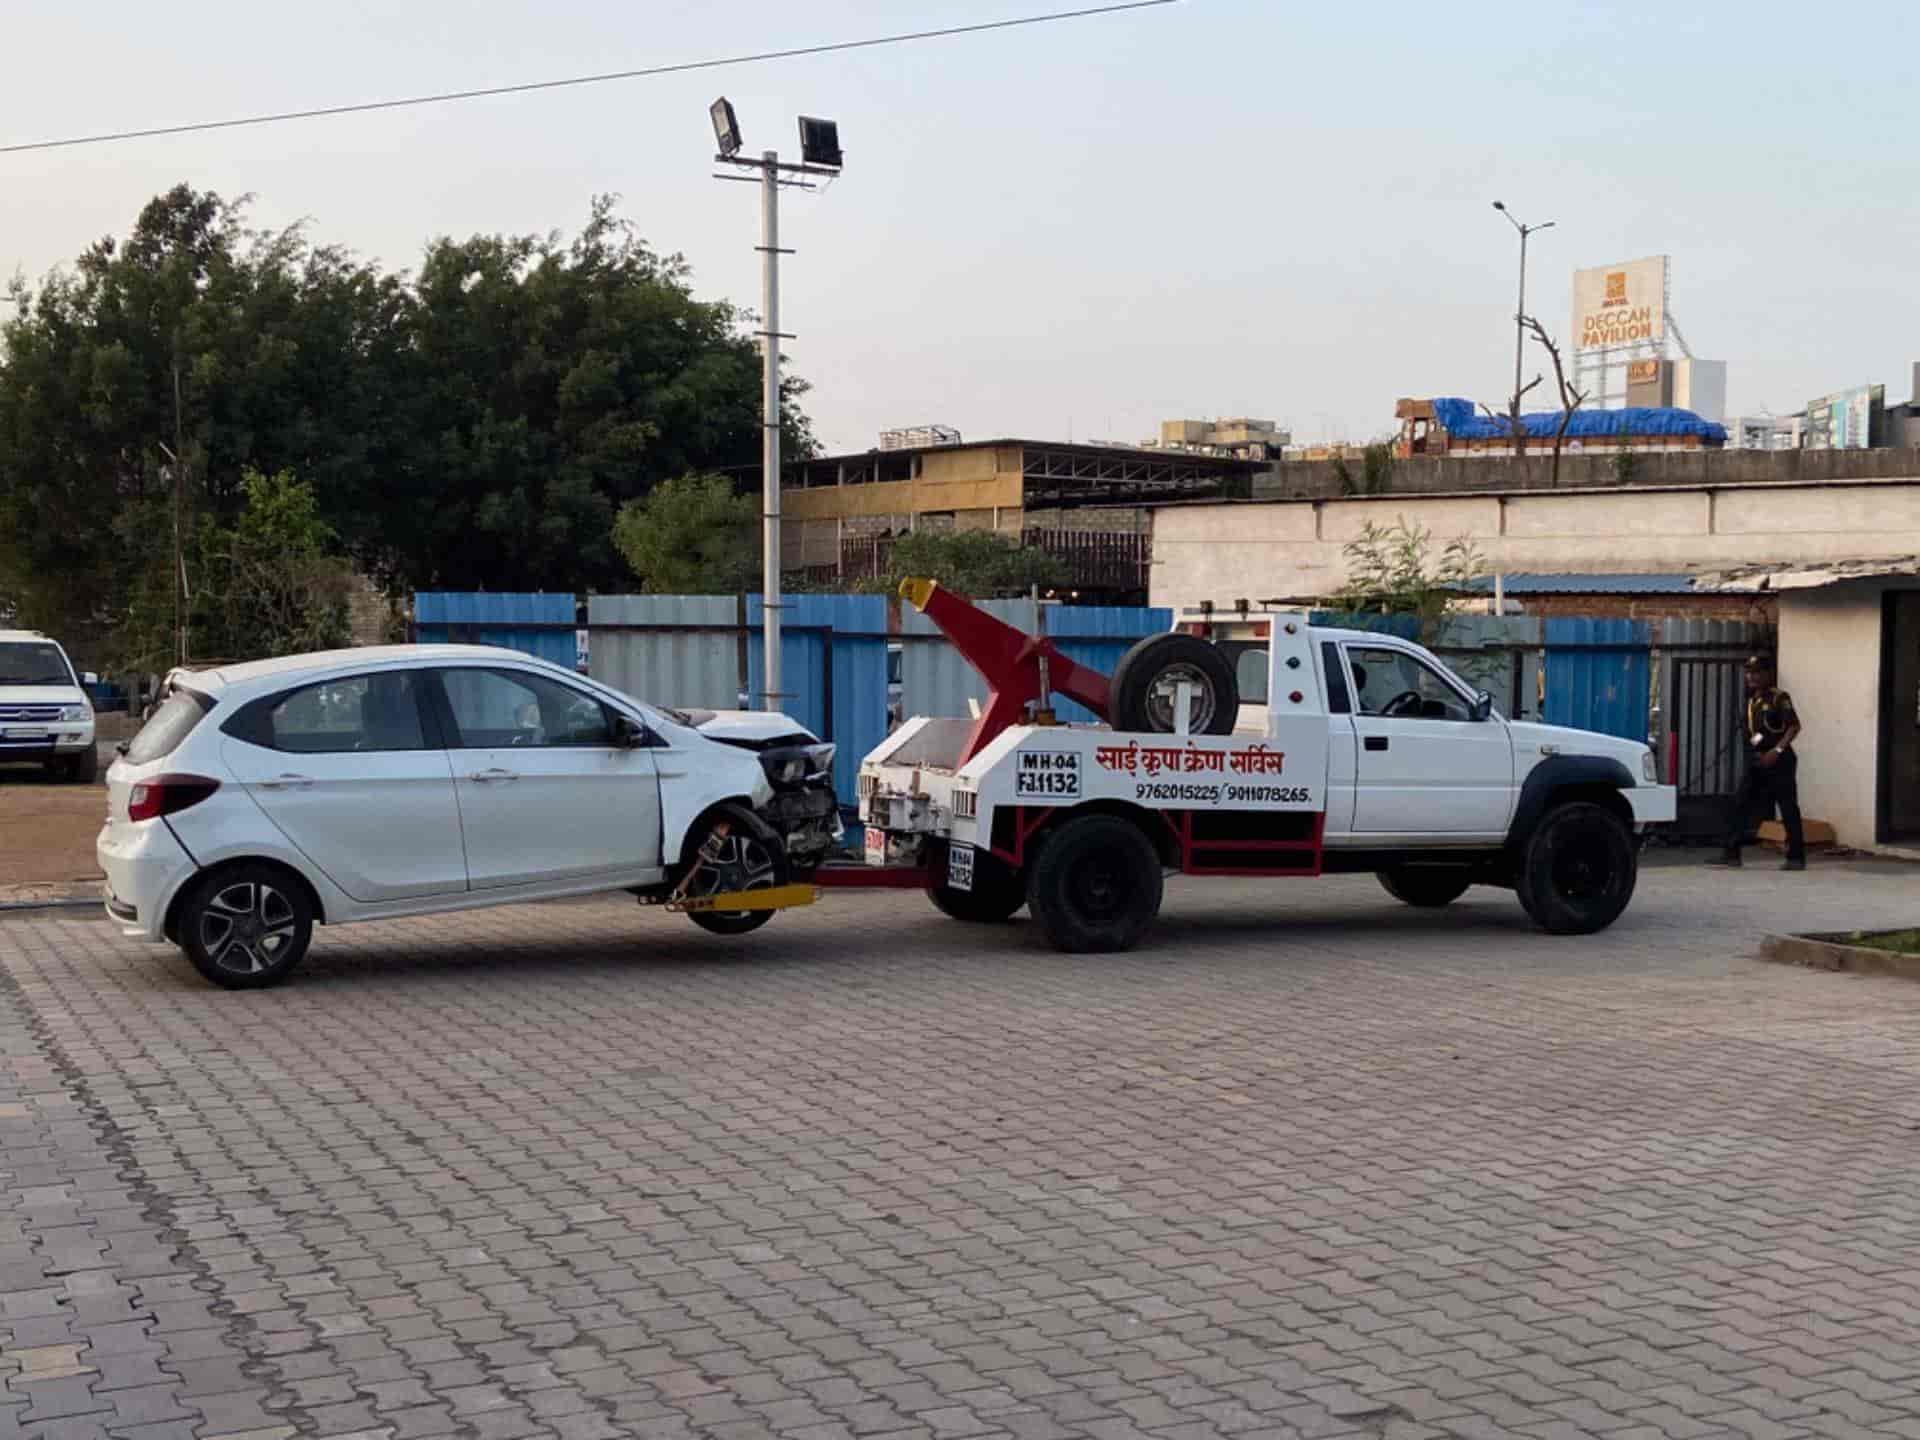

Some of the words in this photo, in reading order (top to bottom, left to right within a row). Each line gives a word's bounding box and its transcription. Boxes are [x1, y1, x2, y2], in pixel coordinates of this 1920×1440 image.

[1585, 308, 1650, 331] DECCAN
[1583, 322, 1652, 346] PAVILION
[1096, 740, 1137, 777] साई
[1141, 748, 1182, 777] कृपा
[1230, 744, 1284, 775] सर्विस
